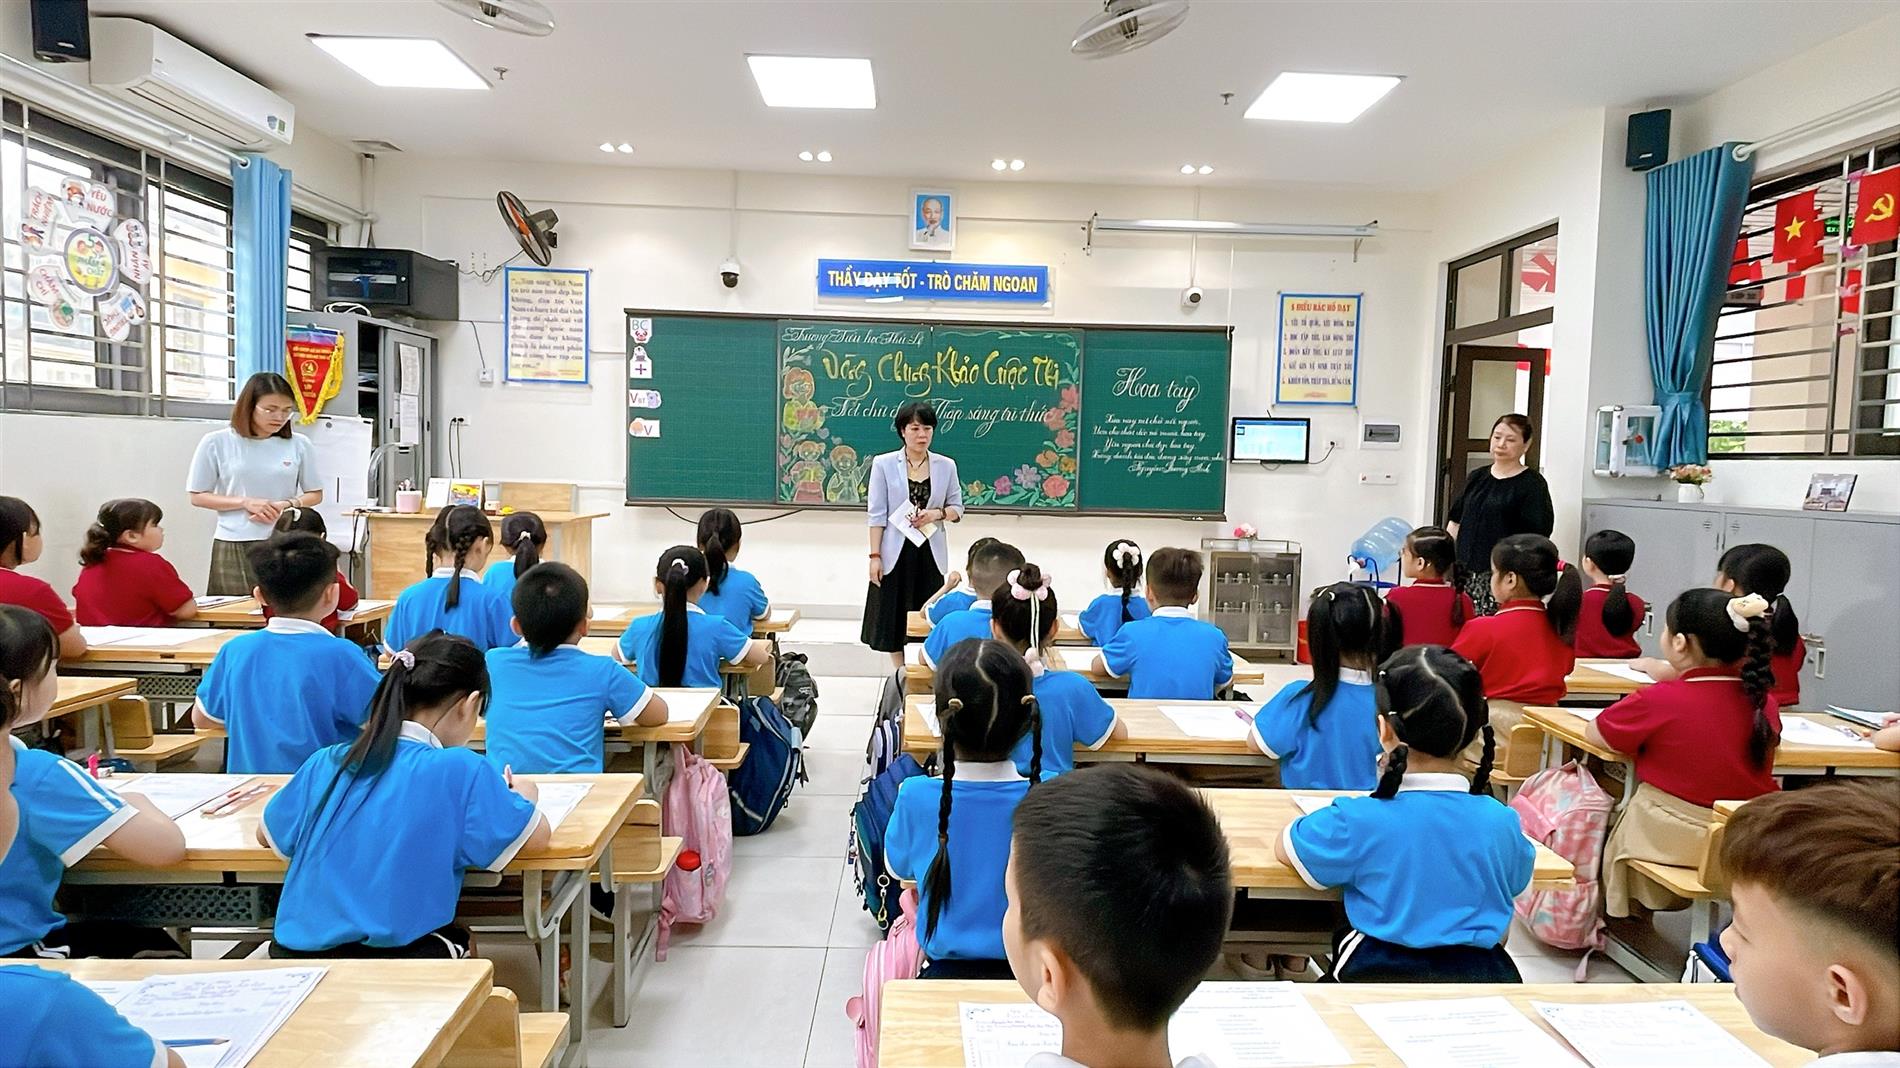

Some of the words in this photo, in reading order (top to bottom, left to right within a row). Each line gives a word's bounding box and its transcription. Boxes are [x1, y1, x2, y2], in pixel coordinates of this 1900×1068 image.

[828, 264, 860, 287] THẦY
[894, 266, 917, 289] TỐT
[927, 270, 950, 290] TRÒ
[954, 271, 990, 291] CHĂM
[993, 275, 1038, 293] NGOAN
[631, 319, 649, 331] BC
[932, 346, 979, 388] Khảo
[983, 350, 1028, 391] Cuộc
[1032, 355, 1060, 390] Thi
[1112, 366, 1161, 398] Hoa
[1166, 375, 1200, 413] tay
[966, 405, 1000, 438] sáng
